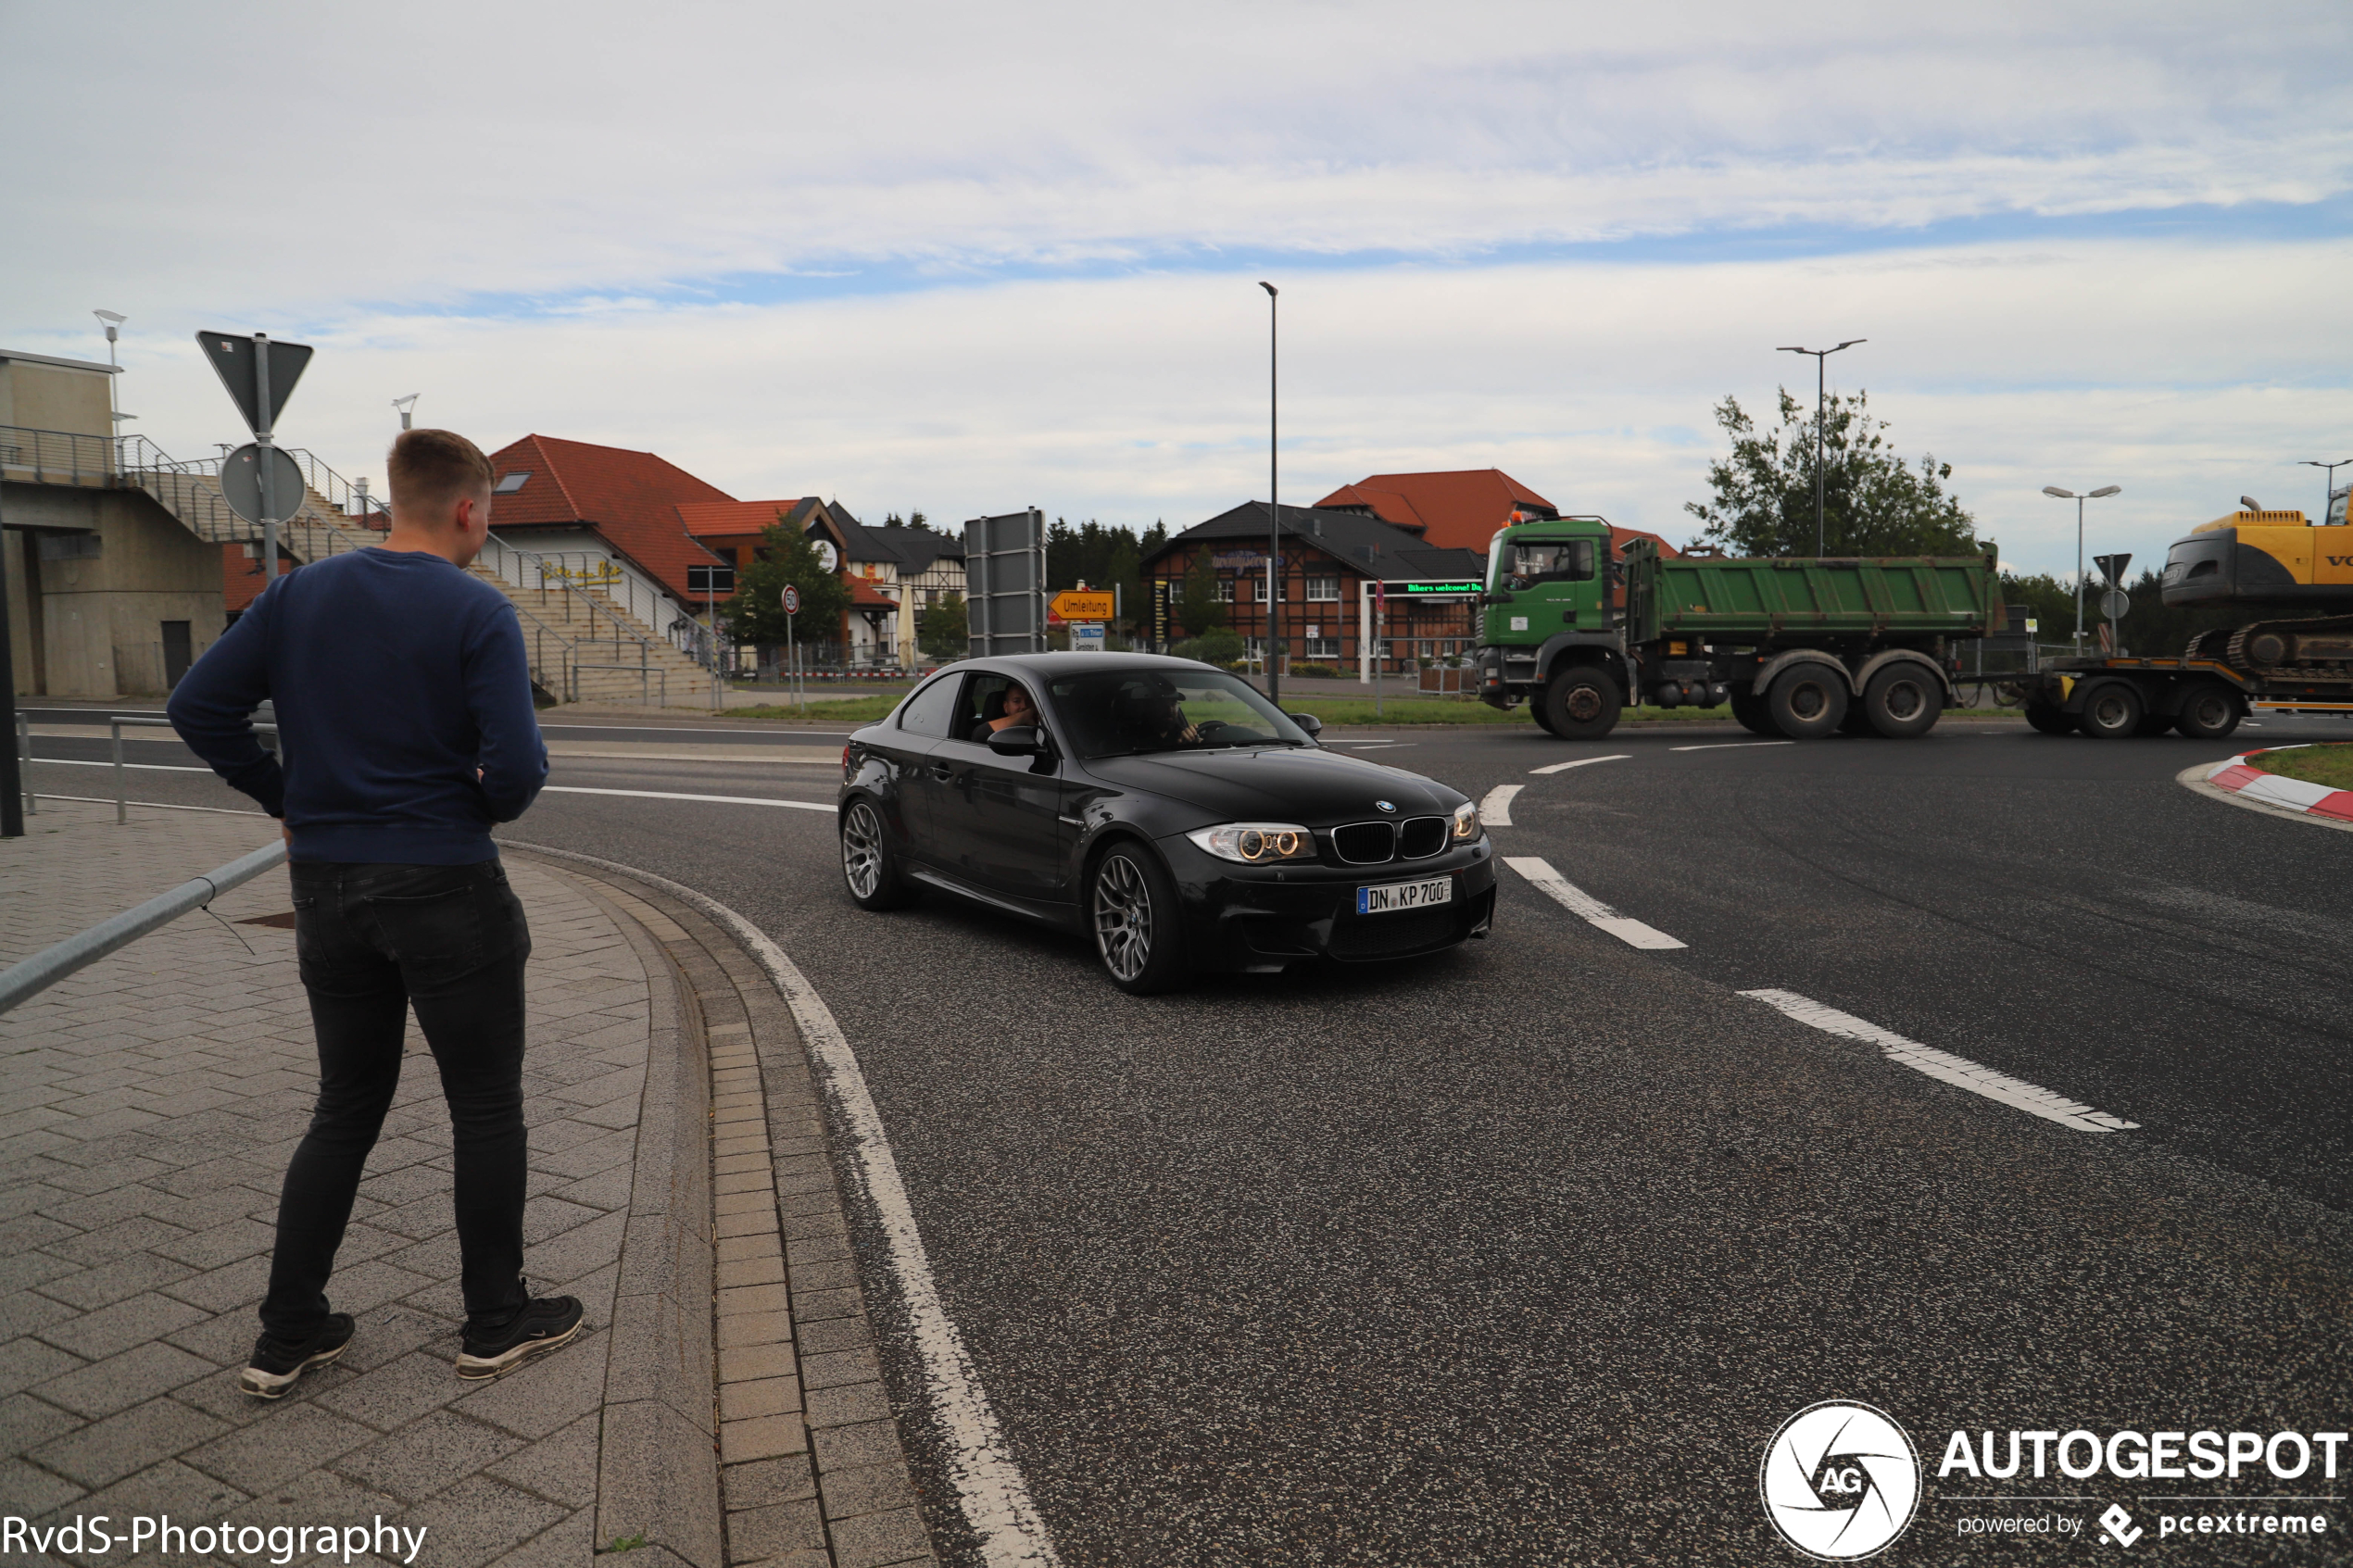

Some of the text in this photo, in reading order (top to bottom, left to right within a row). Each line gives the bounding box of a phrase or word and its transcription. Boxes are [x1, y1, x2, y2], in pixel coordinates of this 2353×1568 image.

[1408, 583, 1434, 592] Bikers
[1435, 583, 1469, 592] welcome!
[786, 594, 796, 607] 50
[1063, 598, 1107, 616] Umleitung
[1368, 881, 1443, 910] DN KP 700
